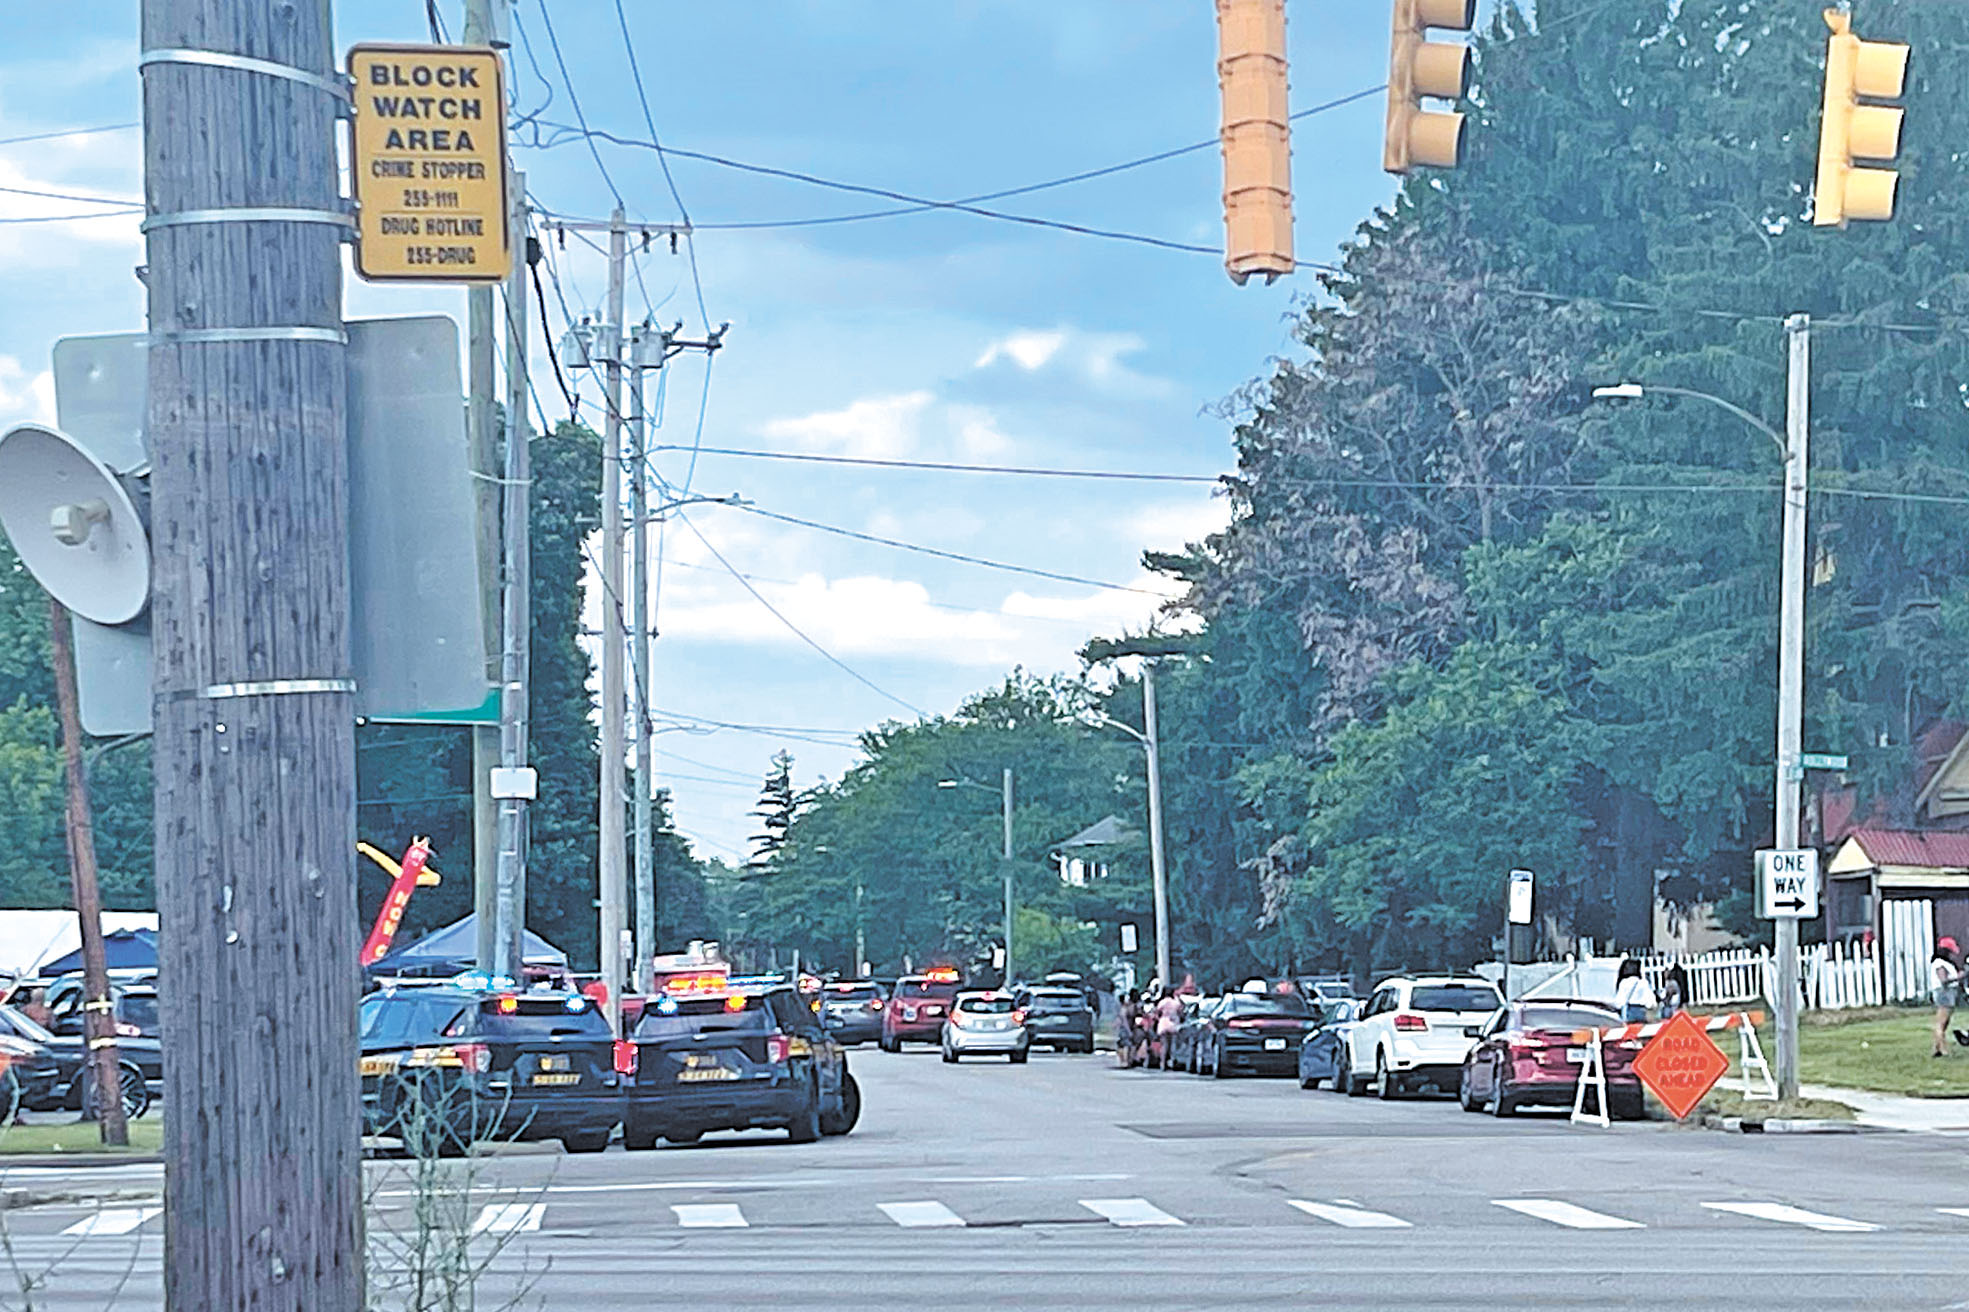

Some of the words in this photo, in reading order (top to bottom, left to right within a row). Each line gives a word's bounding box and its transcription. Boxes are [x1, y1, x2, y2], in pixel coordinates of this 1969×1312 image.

[370, 65, 480, 88] BLOCK
[373, 96, 481, 120] WATCH
[385, 129, 475, 151] AREA
[372, 161, 415, 178] CRIME
[422, 161, 486, 180] STOPPER
[381, 217, 419, 235] DRUG
[426, 218, 484, 236] HOTLINE
[407, 247, 476, 264] 255-DRUG
[1773, 855, 1805, 871] ONE
[1774, 877, 1806, 894] WAY
[1662, 1036, 1701, 1052] ROAD
[1656, 1055, 1708, 1071] CLOSED
[1660, 1073, 1706, 1088] AHEAD
